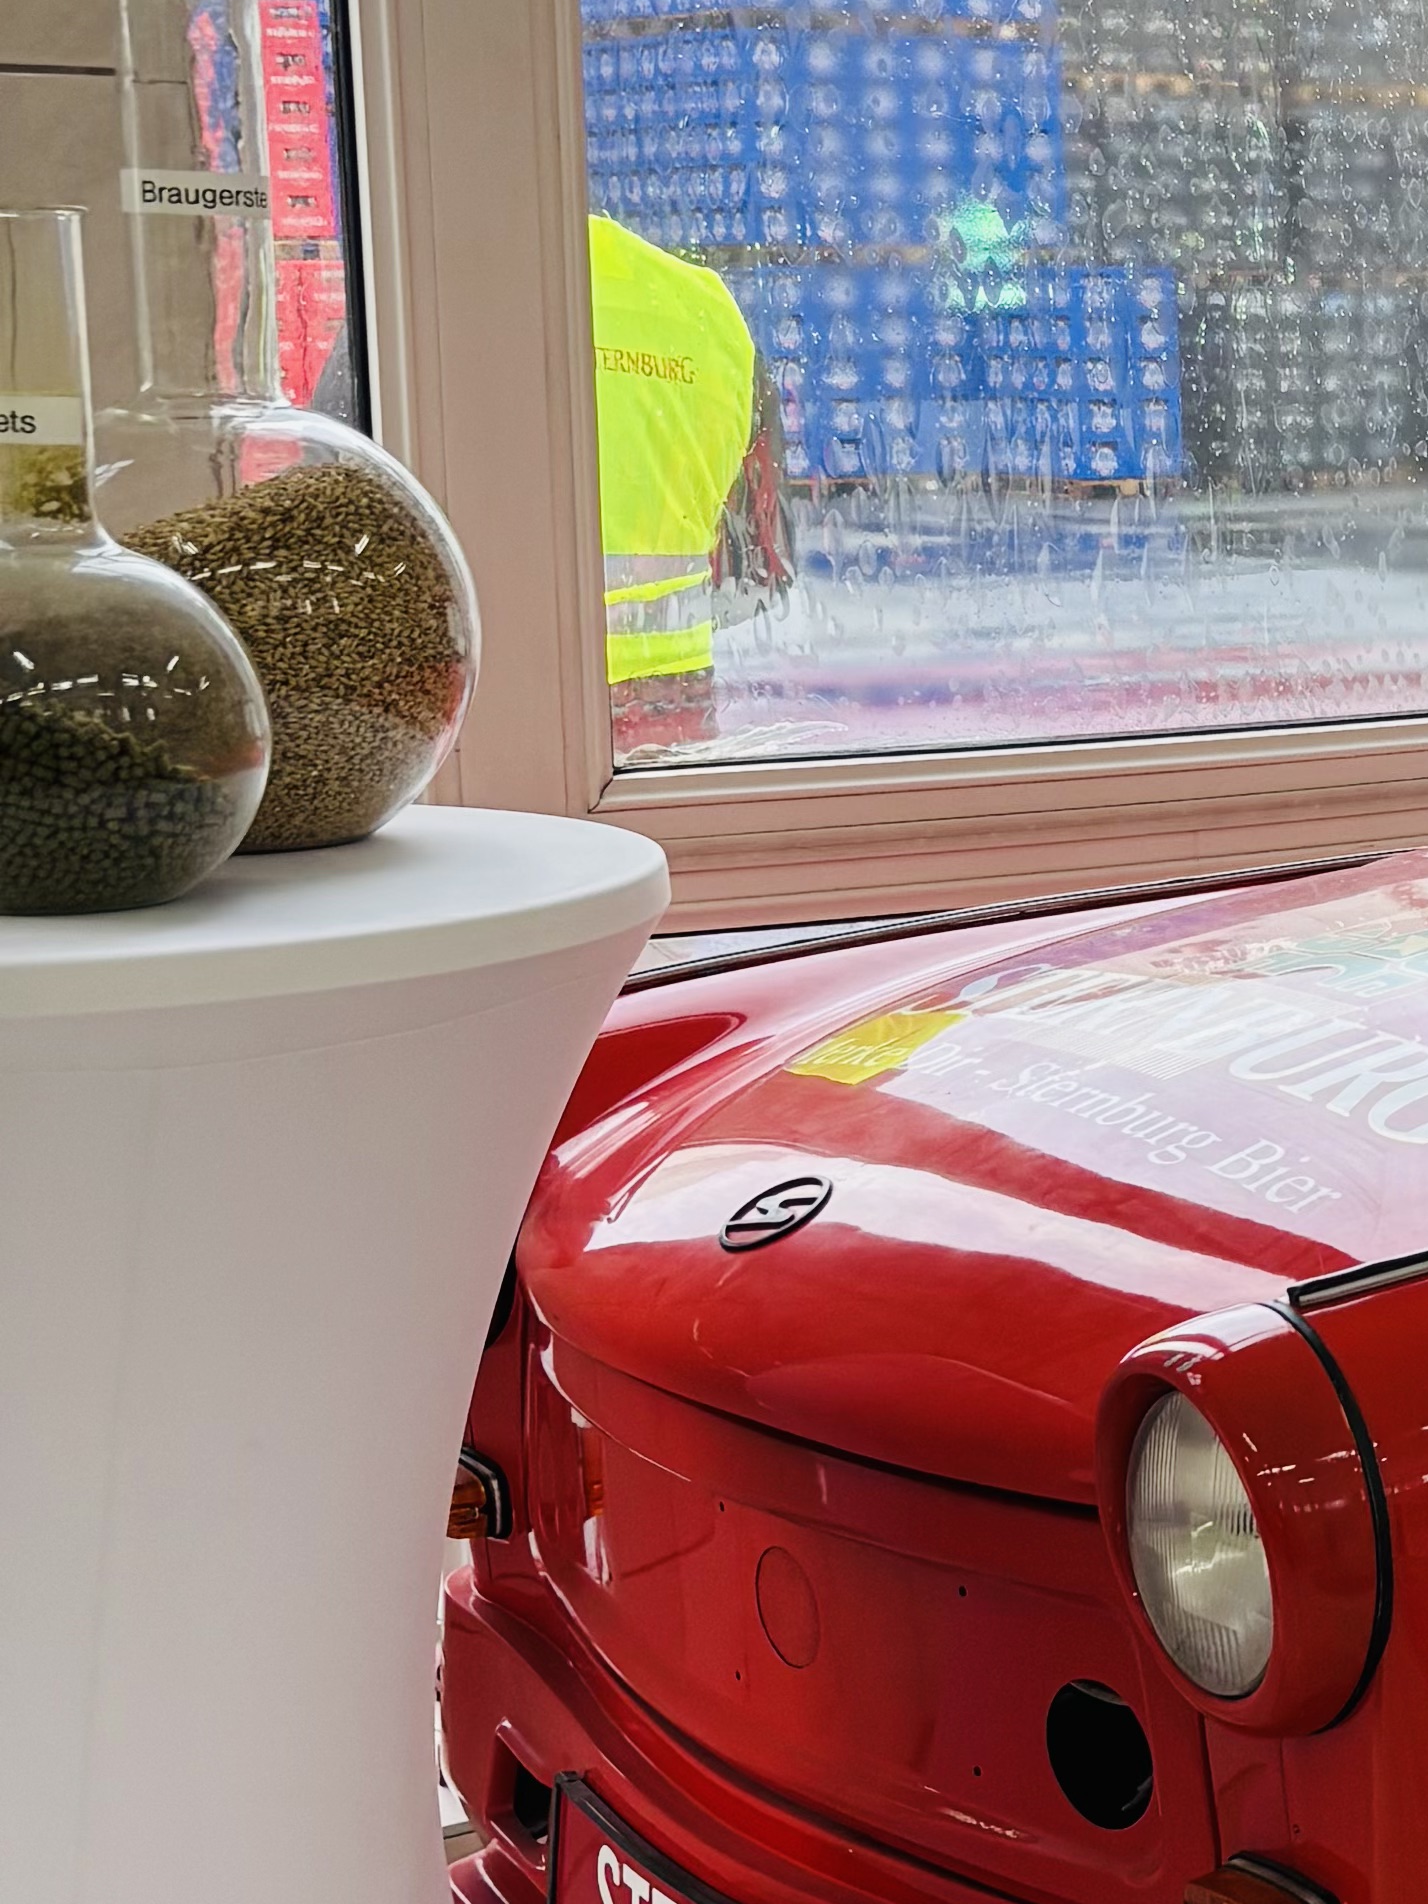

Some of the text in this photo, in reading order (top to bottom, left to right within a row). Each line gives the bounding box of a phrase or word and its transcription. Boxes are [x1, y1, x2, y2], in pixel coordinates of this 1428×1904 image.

[141, 180, 268, 209] Braugerste
[987, 1058, 1223, 1165] Sternburg
[1205, 1137, 1343, 1213] Bier
